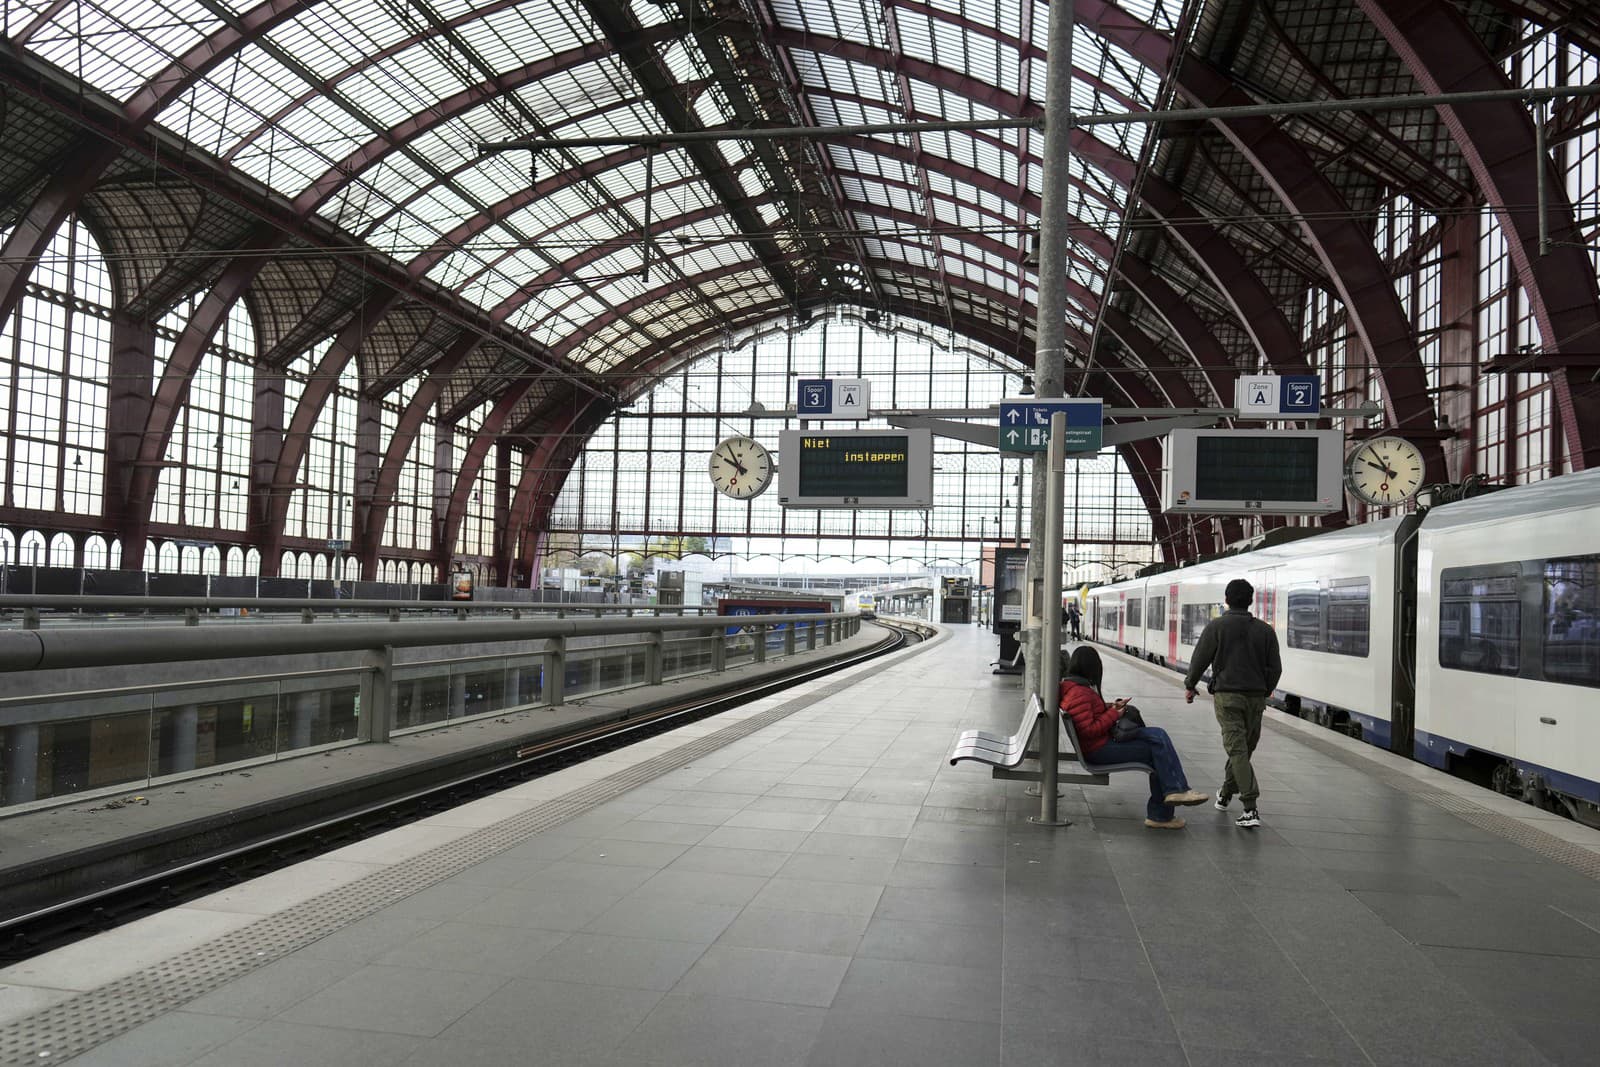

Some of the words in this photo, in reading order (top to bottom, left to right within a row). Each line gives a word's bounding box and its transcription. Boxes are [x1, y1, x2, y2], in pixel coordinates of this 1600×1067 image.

[811, 393, 819, 405] 3
[845, 393, 854, 405] A
[1255, 391, 1265, 403] A
[1295, 390, 1304, 404] 2
[804, 438, 831, 448] Niet
[845, 451, 904, 462] instappen
